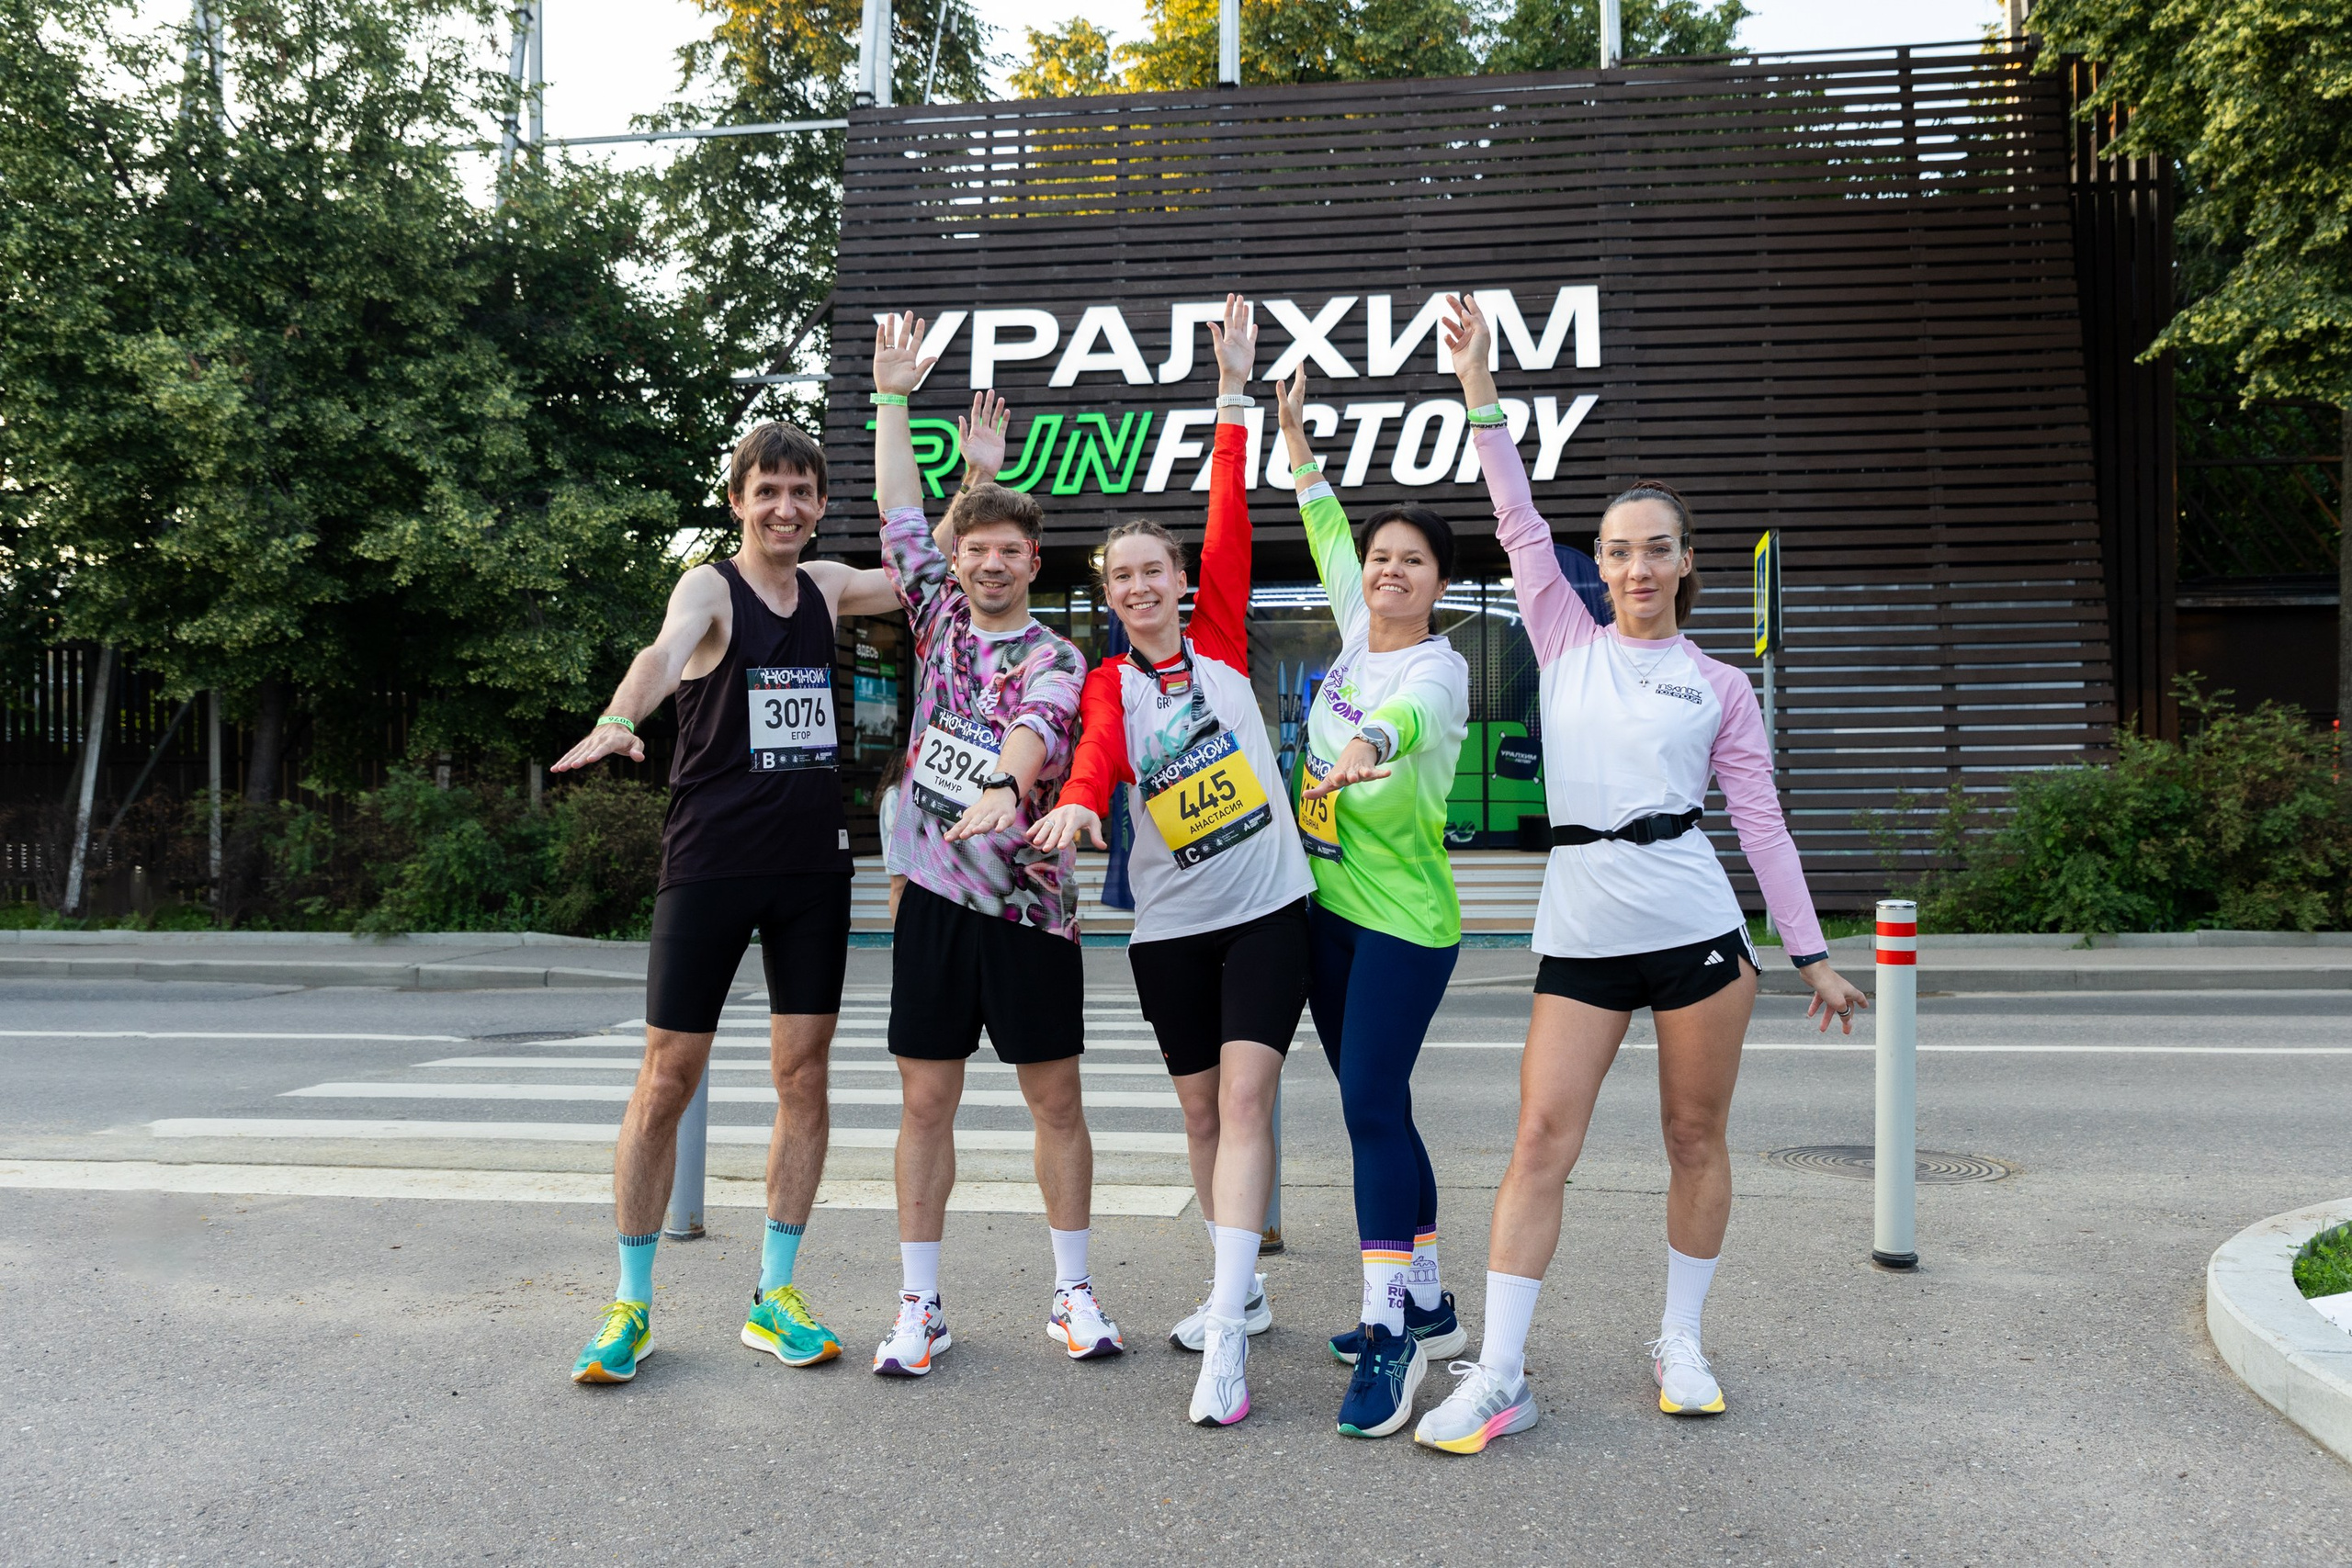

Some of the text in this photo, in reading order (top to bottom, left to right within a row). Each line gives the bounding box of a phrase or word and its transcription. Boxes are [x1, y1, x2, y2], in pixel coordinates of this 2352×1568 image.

[873, 285, 1601, 391] УРАЛХИМ
[856, 643, 879, 659] ЗДЕСЬ
[764, 697, 826, 729] 3076
[791, 731, 811, 740] ЕГОР
[924, 739, 989, 790] 2394
[1500, 750, 1537, 761] УРАЛХИМ
[935, 775, 963, 794] ТИМУР
[1180, 769, 1237, 821] 445
[1190, 799, 1244, 835] АНАСТАСИЯ
